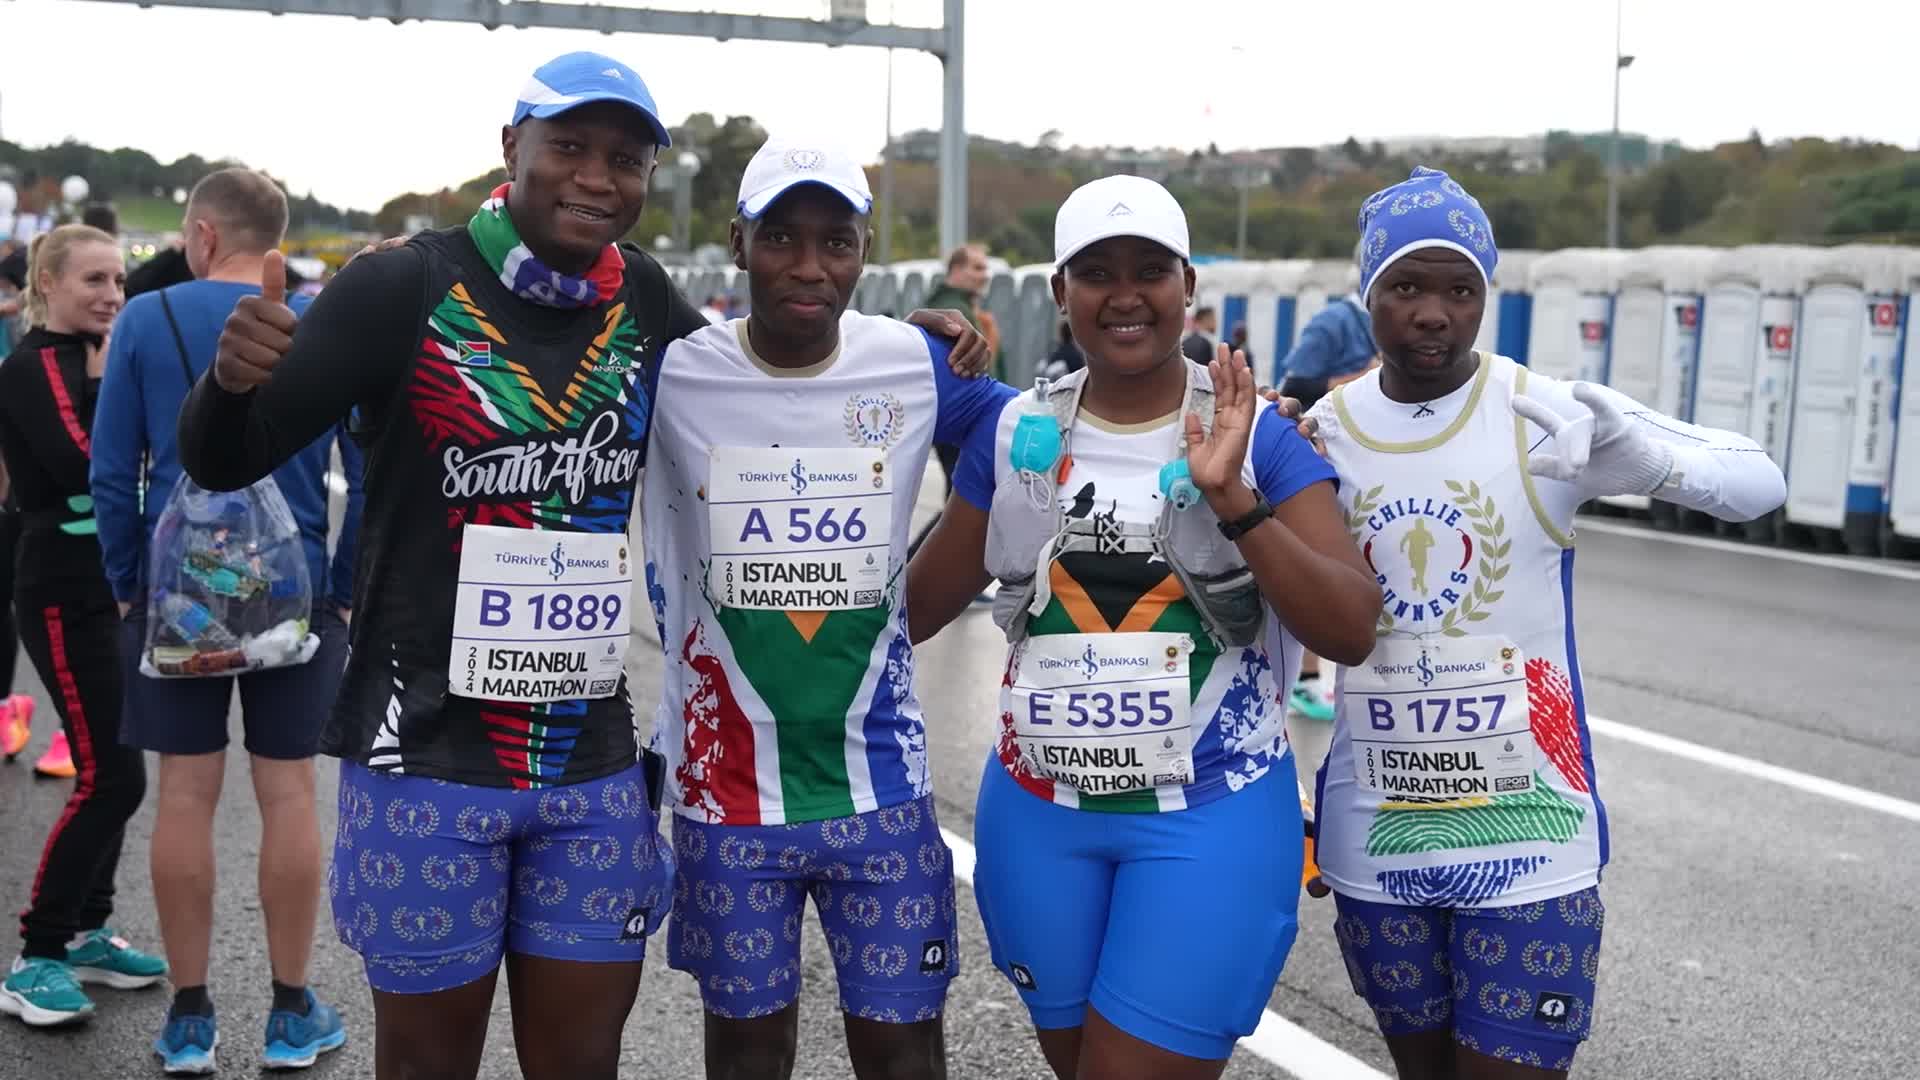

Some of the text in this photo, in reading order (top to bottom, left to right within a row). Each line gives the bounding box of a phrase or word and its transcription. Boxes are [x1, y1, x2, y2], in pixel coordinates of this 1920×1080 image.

[442, 410, 640, 505] South Africa
[738, 471, 788, 482] TÜRKİYE
[809, 472, 857, 482] BANKASI
[739, 507, 866, 543] A 566
[1367, 498, 1462, 532] CHILLIE
[495, 552, 548, 566] TÜRKİYE
[566, 558, 609, 569] BANKASI
[743, 562, 847, 583] ISTANBUL
[740, 589, 848, 606] MARATHON
[479, 589, 622, 631] B 1889
[487, 649, 588, 673] ISTANBUL
[1039, 657, 1081, 669] TÜRKİYE
[1100, 657, 1149, 667] BANKASI
[1374, 663, 1415, 674] TÜRKİYE
[1435, 662, 1486, 673] BANKASI
[482, 677, 587, 697] MARATHON
[1029, 690, 1173, 728] E 5355
[1368, 694, 1506, 733] B 1757
[1043, 745, 1143, 768] ISTANBUL
[1382, 749, 1484, 772] ISTANBUL
[1382, 774, 1488, 793] MARATHON
